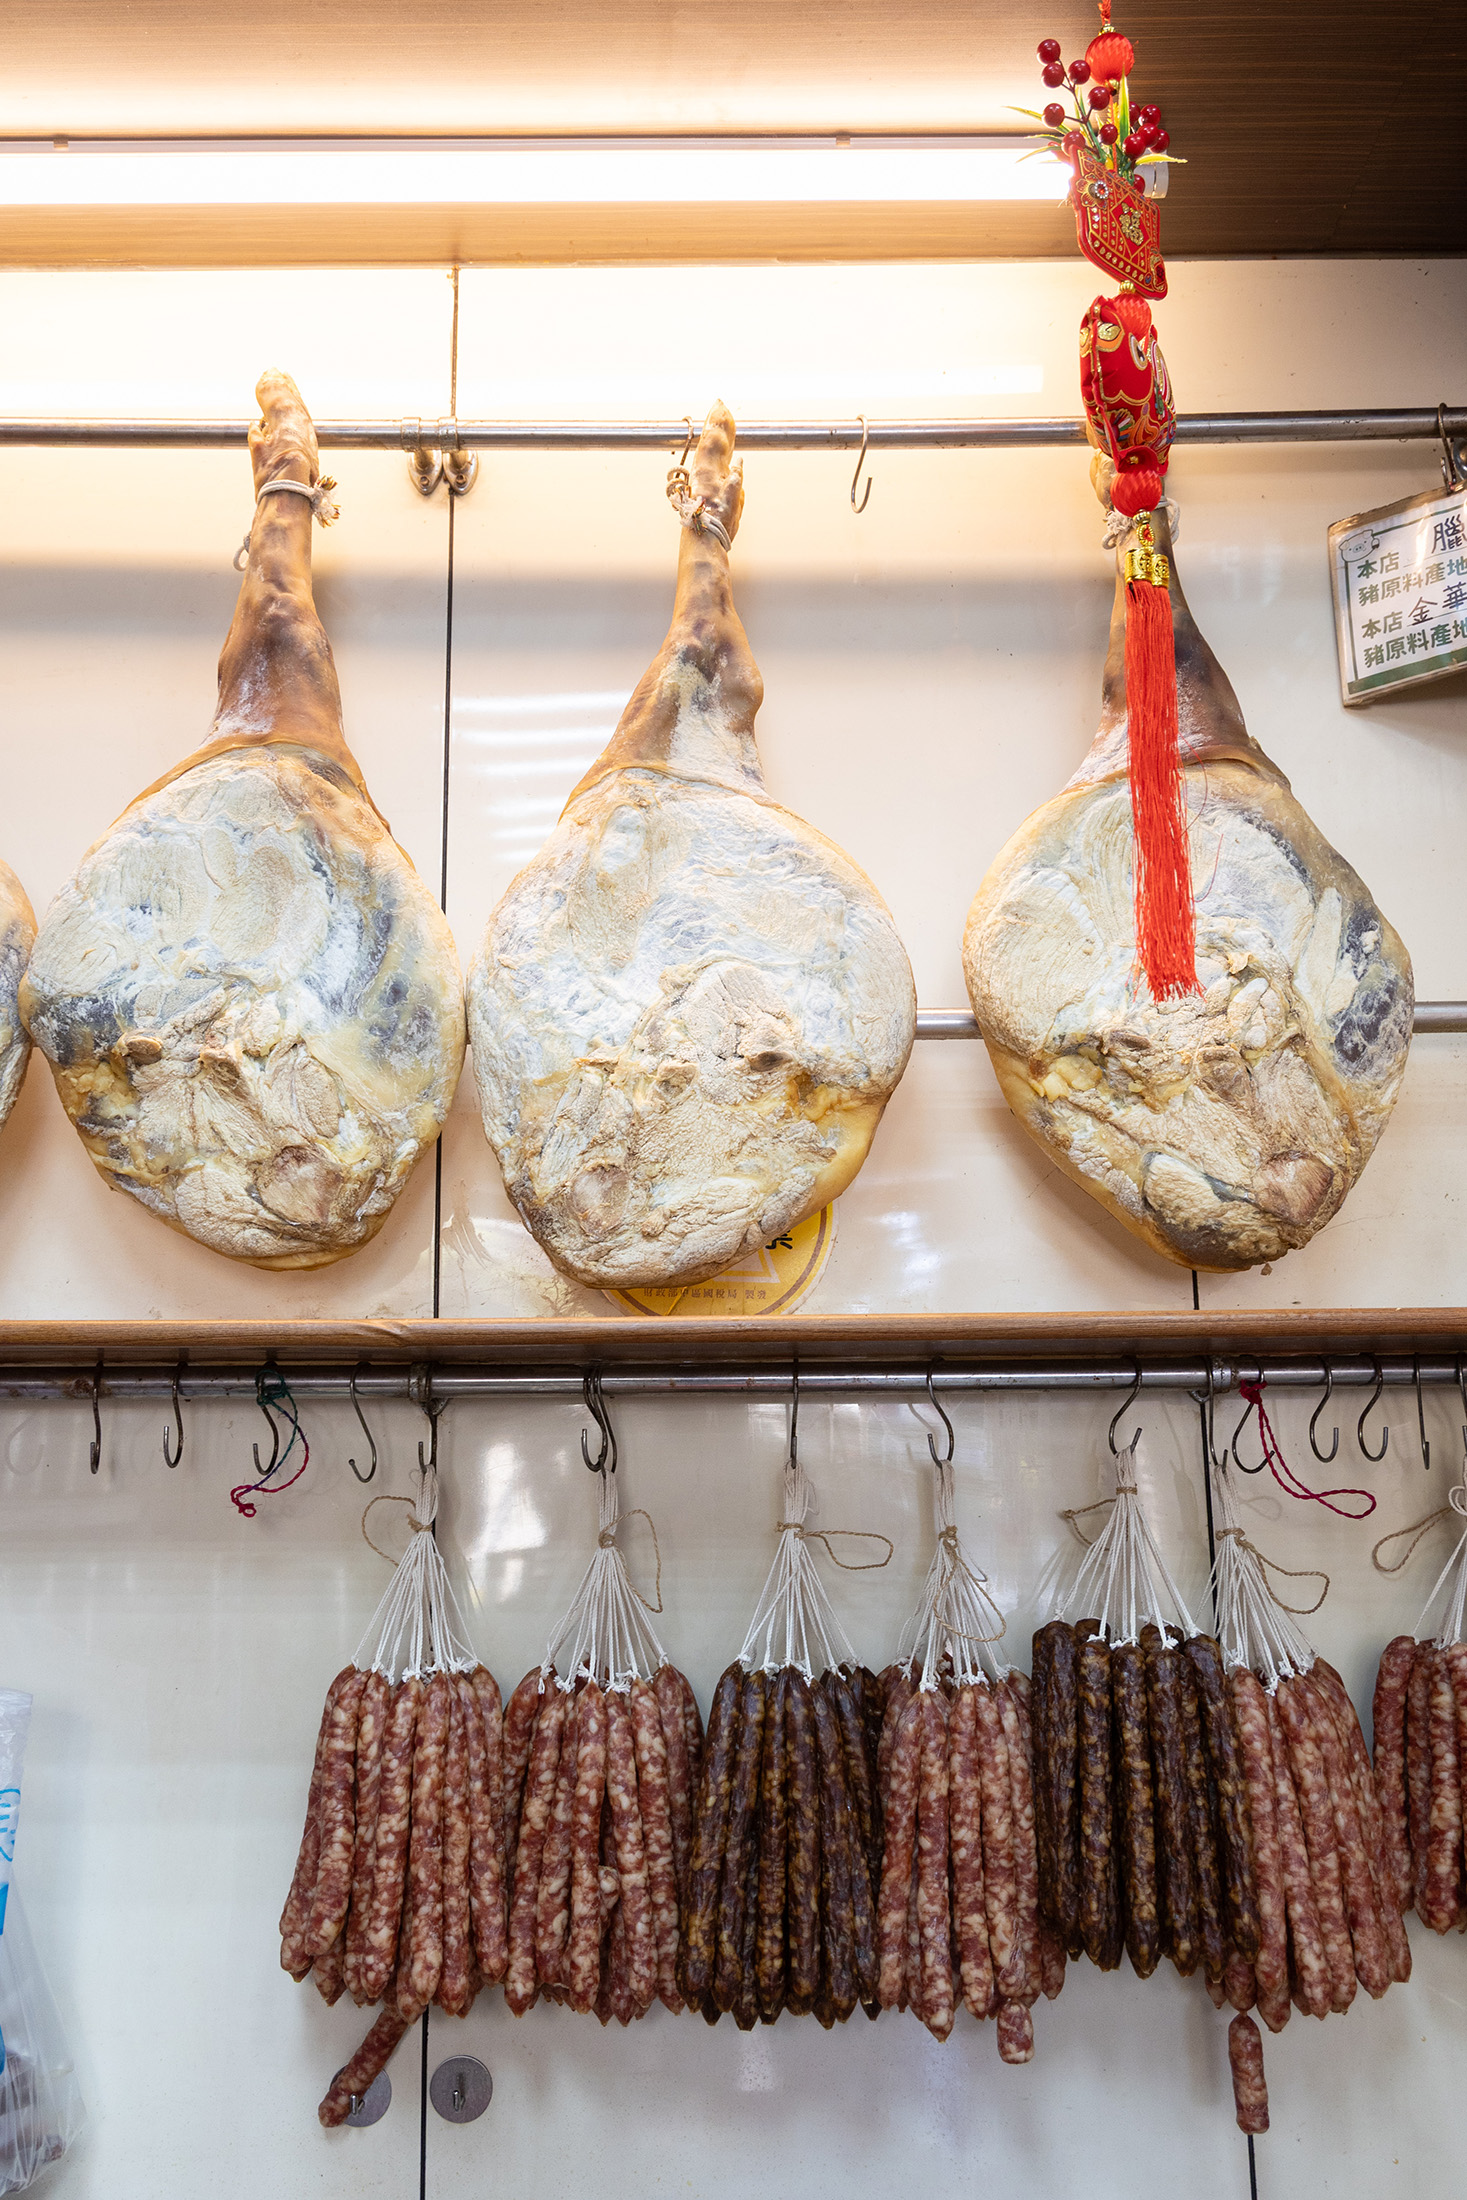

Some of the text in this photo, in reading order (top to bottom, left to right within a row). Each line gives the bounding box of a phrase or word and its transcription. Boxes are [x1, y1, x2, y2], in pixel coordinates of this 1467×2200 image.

[1357, 552, 1400, 579] 本店
[1358, 556, 1467, 606] 豬原料產地
[1362, 582, 1467, 640] 本店 金華
[1364, 617, 1467, 668] 豬原料產地
